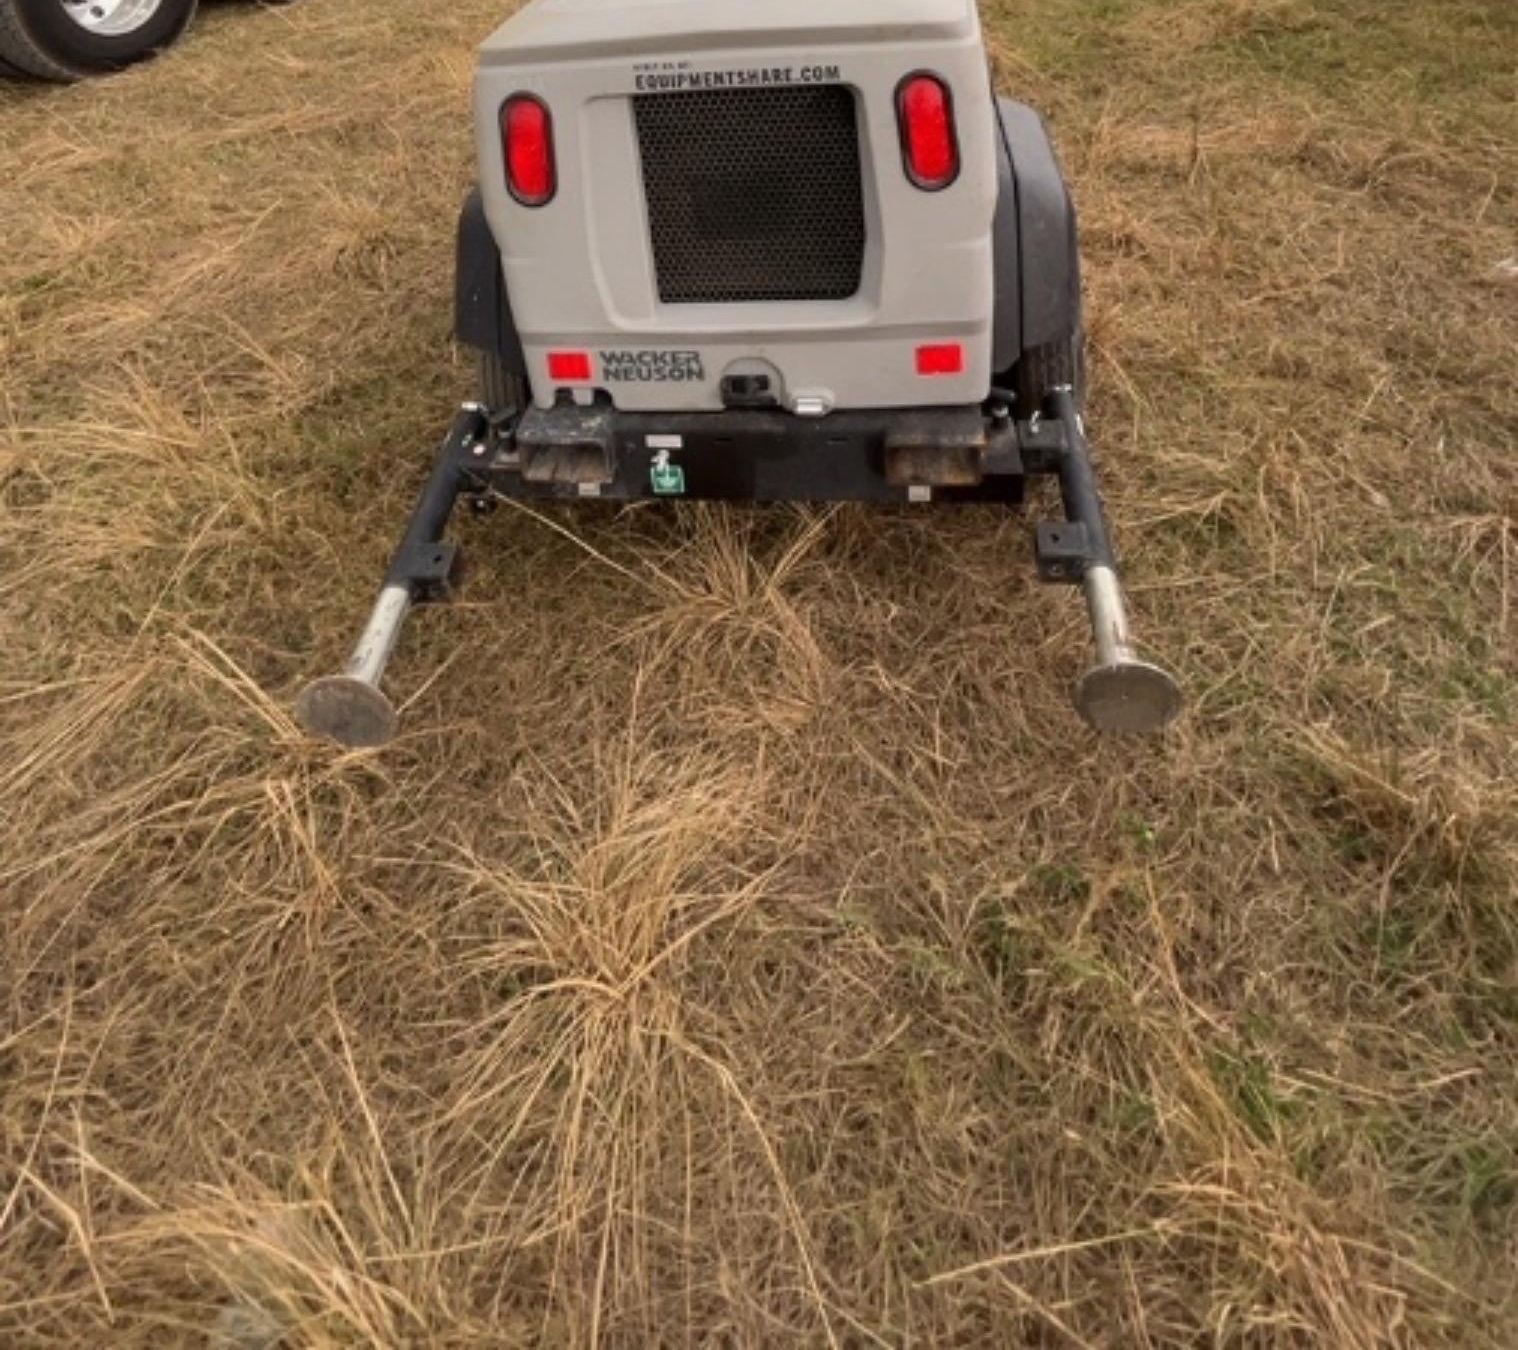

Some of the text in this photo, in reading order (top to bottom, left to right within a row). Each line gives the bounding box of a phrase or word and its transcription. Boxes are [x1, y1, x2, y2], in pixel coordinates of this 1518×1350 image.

[635, 65, 841, 90] EQUIPMENTSHARE.COM
[600, 350, 700, 367] WACKER
[602, 367, 705, 382] NEUSON
